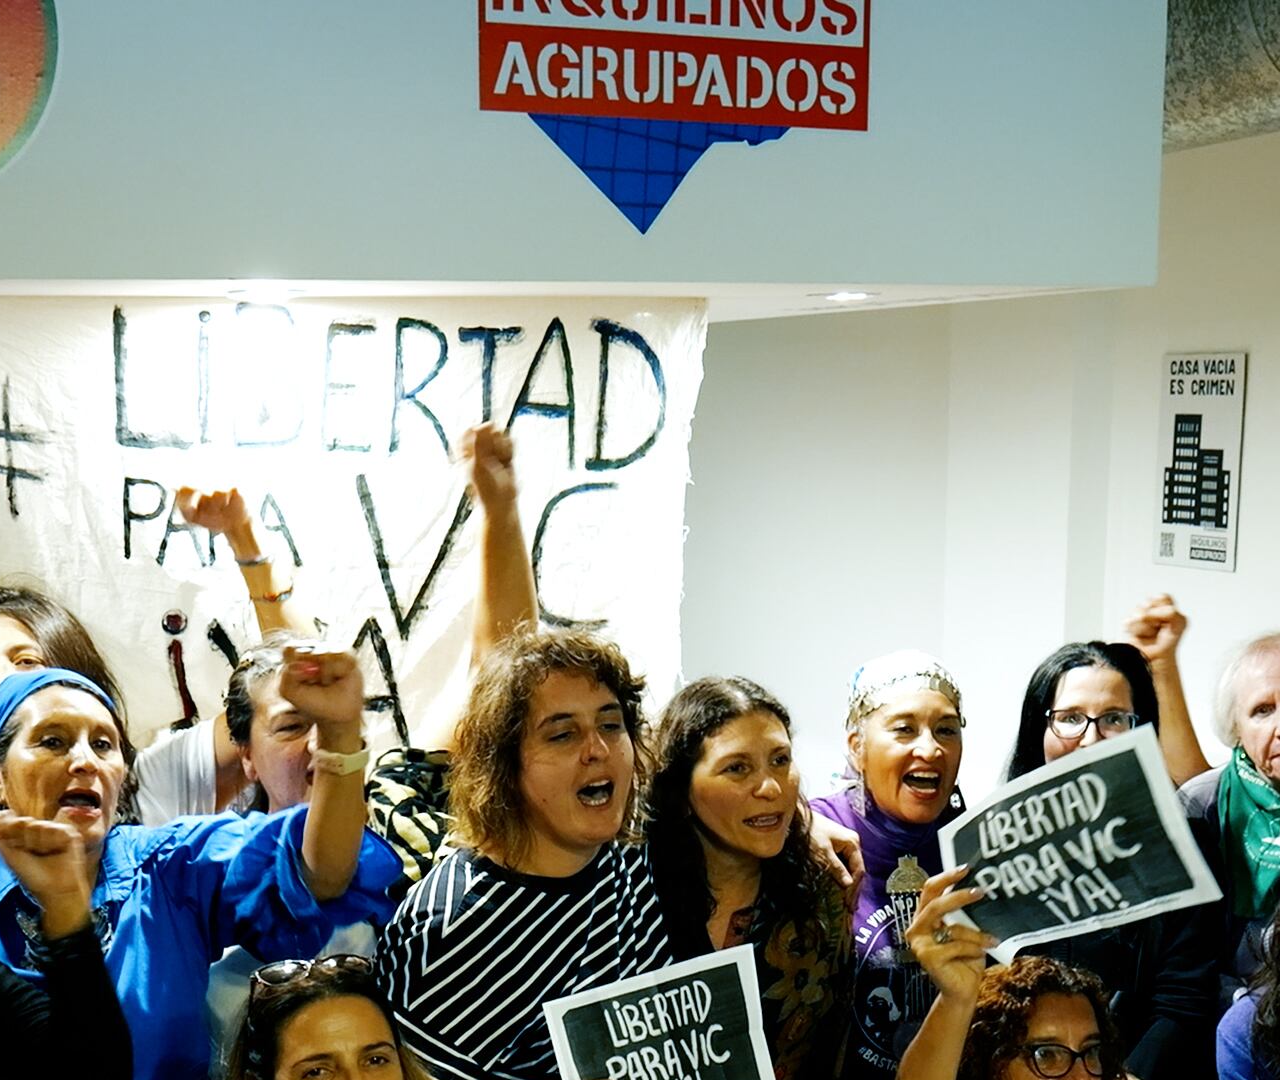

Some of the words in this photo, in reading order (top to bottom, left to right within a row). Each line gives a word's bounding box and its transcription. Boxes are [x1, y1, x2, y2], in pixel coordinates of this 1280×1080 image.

[493, 41, 857, 115] AGRUPADOS
[1170, 360, 1200, 376] CASA
[1203, 359, 1236, 375] VACIA
[1170, 379, 1185, 395] ES
[1191, 379, 1235, 396] CRIMEN
[974, 842, 1074, 902] PARA
[1063, 815, 1143, 871] VIC
[1038, 866, 1131, 926] ¡YA!
[855, 926, 873, 945] LA
[866, 904, 896, 929] VIDA
[681, 1024, 731, 1072] VIC
